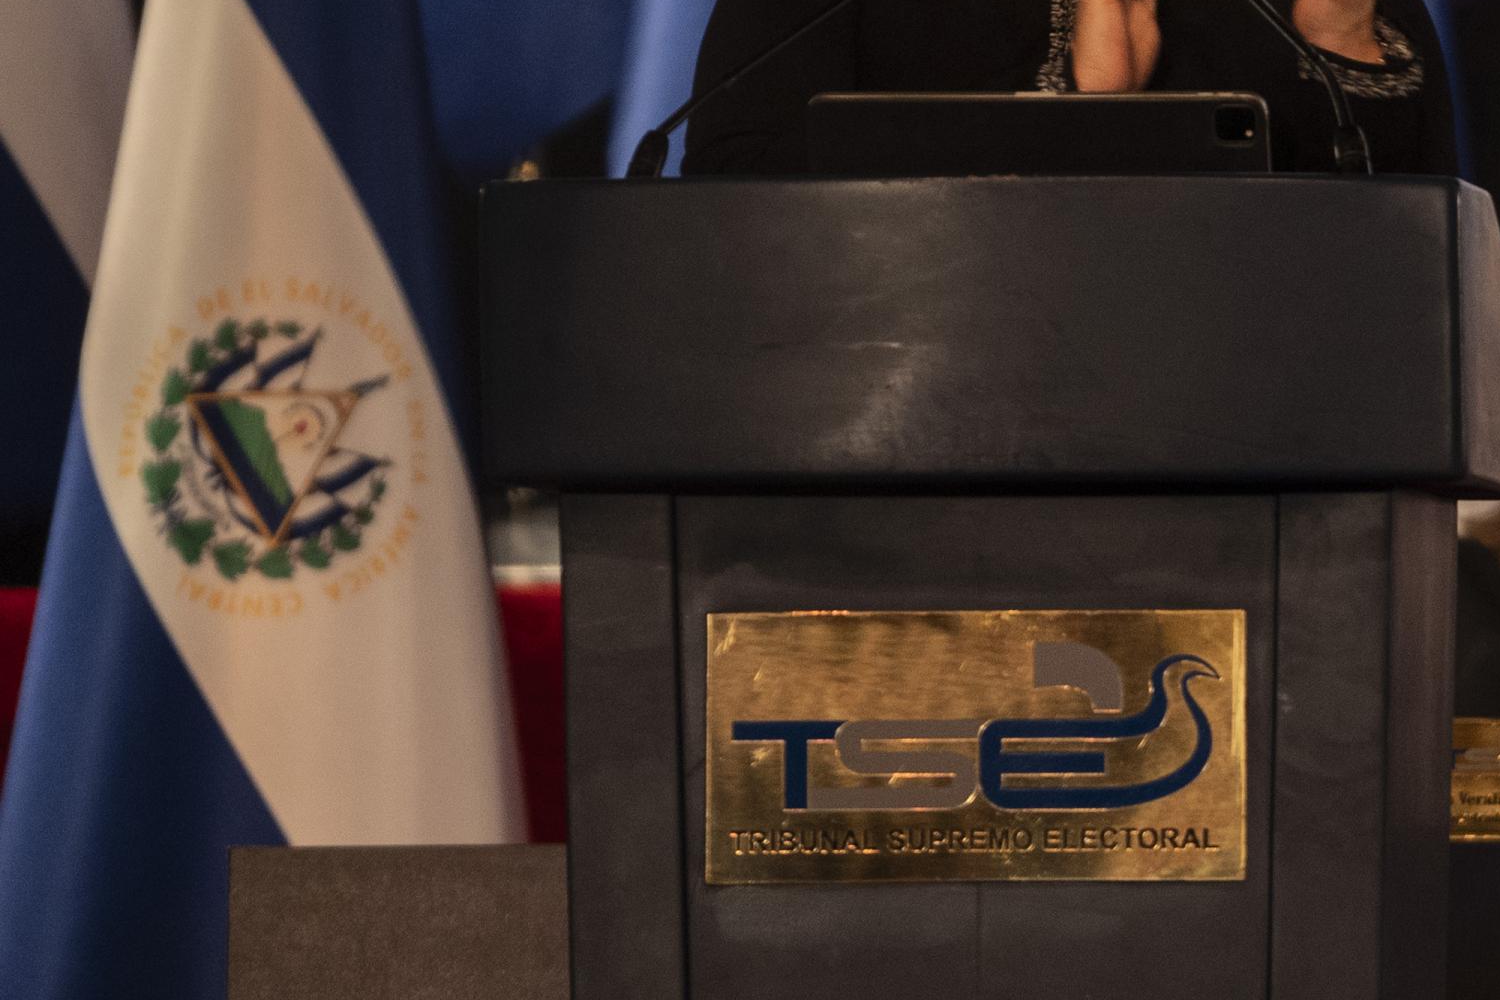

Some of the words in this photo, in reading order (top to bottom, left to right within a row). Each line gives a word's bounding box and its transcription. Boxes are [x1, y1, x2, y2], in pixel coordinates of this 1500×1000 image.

[731, 653, 1221, 812] TSE
[730, 830, 880, 855] TRIBUNAL
[888, 828, 1033, 853] SUPREMO
[1043, 827, 1220, 852] ELECTORAL
